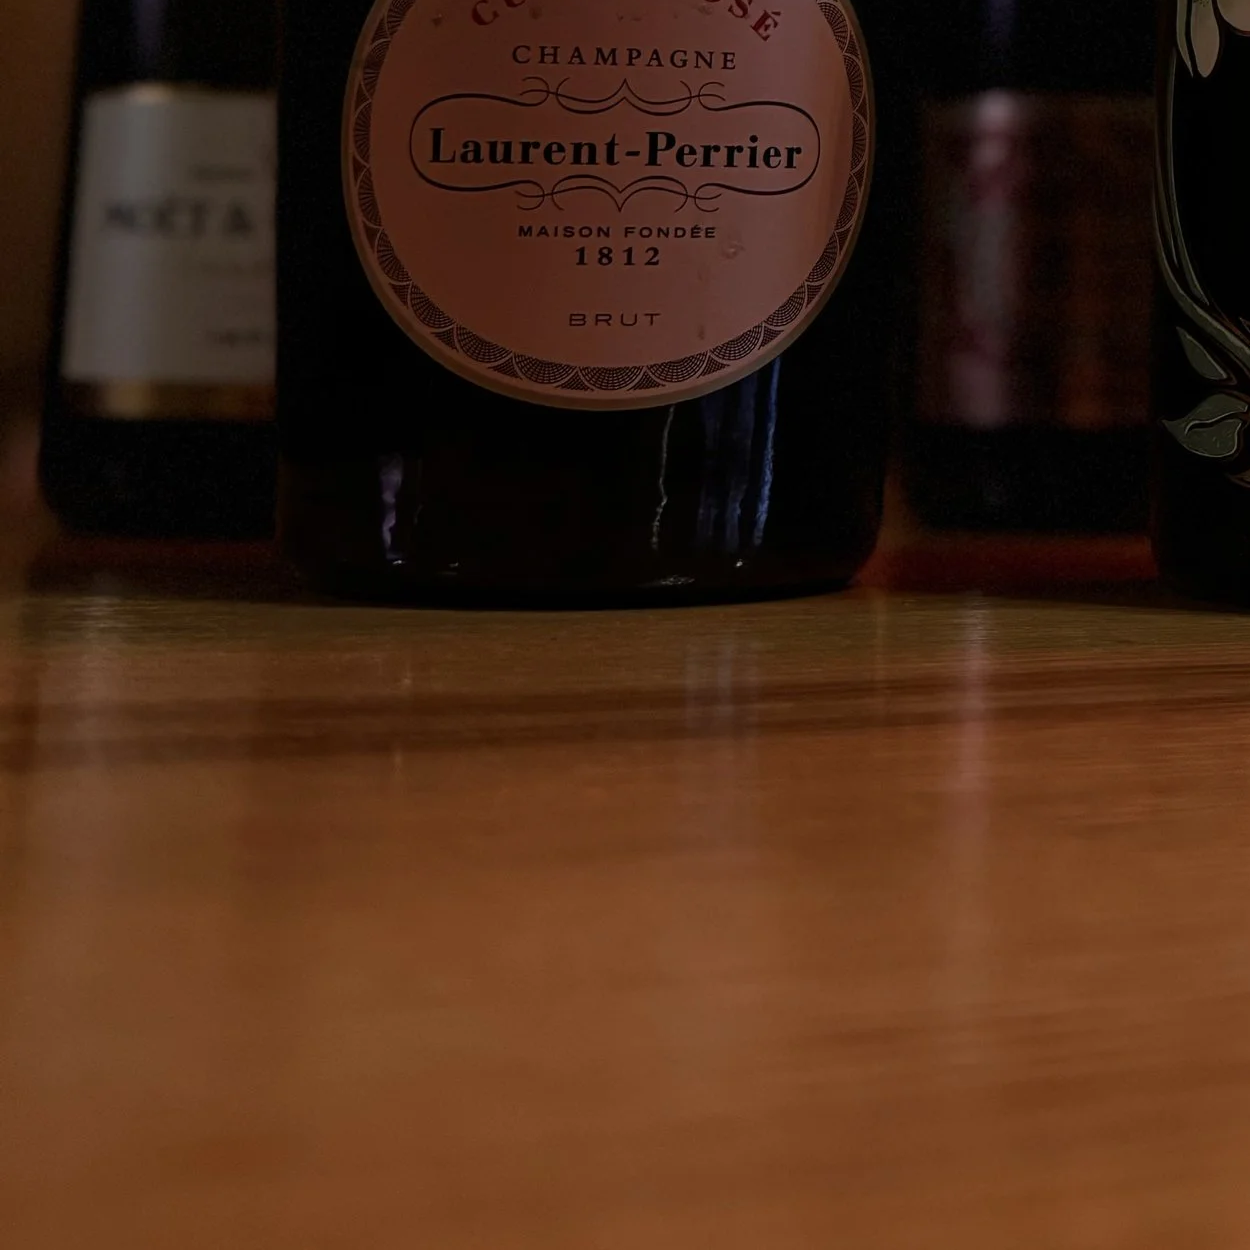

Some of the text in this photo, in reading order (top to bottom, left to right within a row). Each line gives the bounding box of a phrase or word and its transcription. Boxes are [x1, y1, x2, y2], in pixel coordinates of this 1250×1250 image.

[513, 44, 736, 70] CHAMPAGNE
[429, 127, 802, 169] Laurent-Perrier
[518, 223, 716, 239] MAISON FONDÉE
[575, 246, 660, 267] 1812
[569, 313, 661, 327] BRUT
